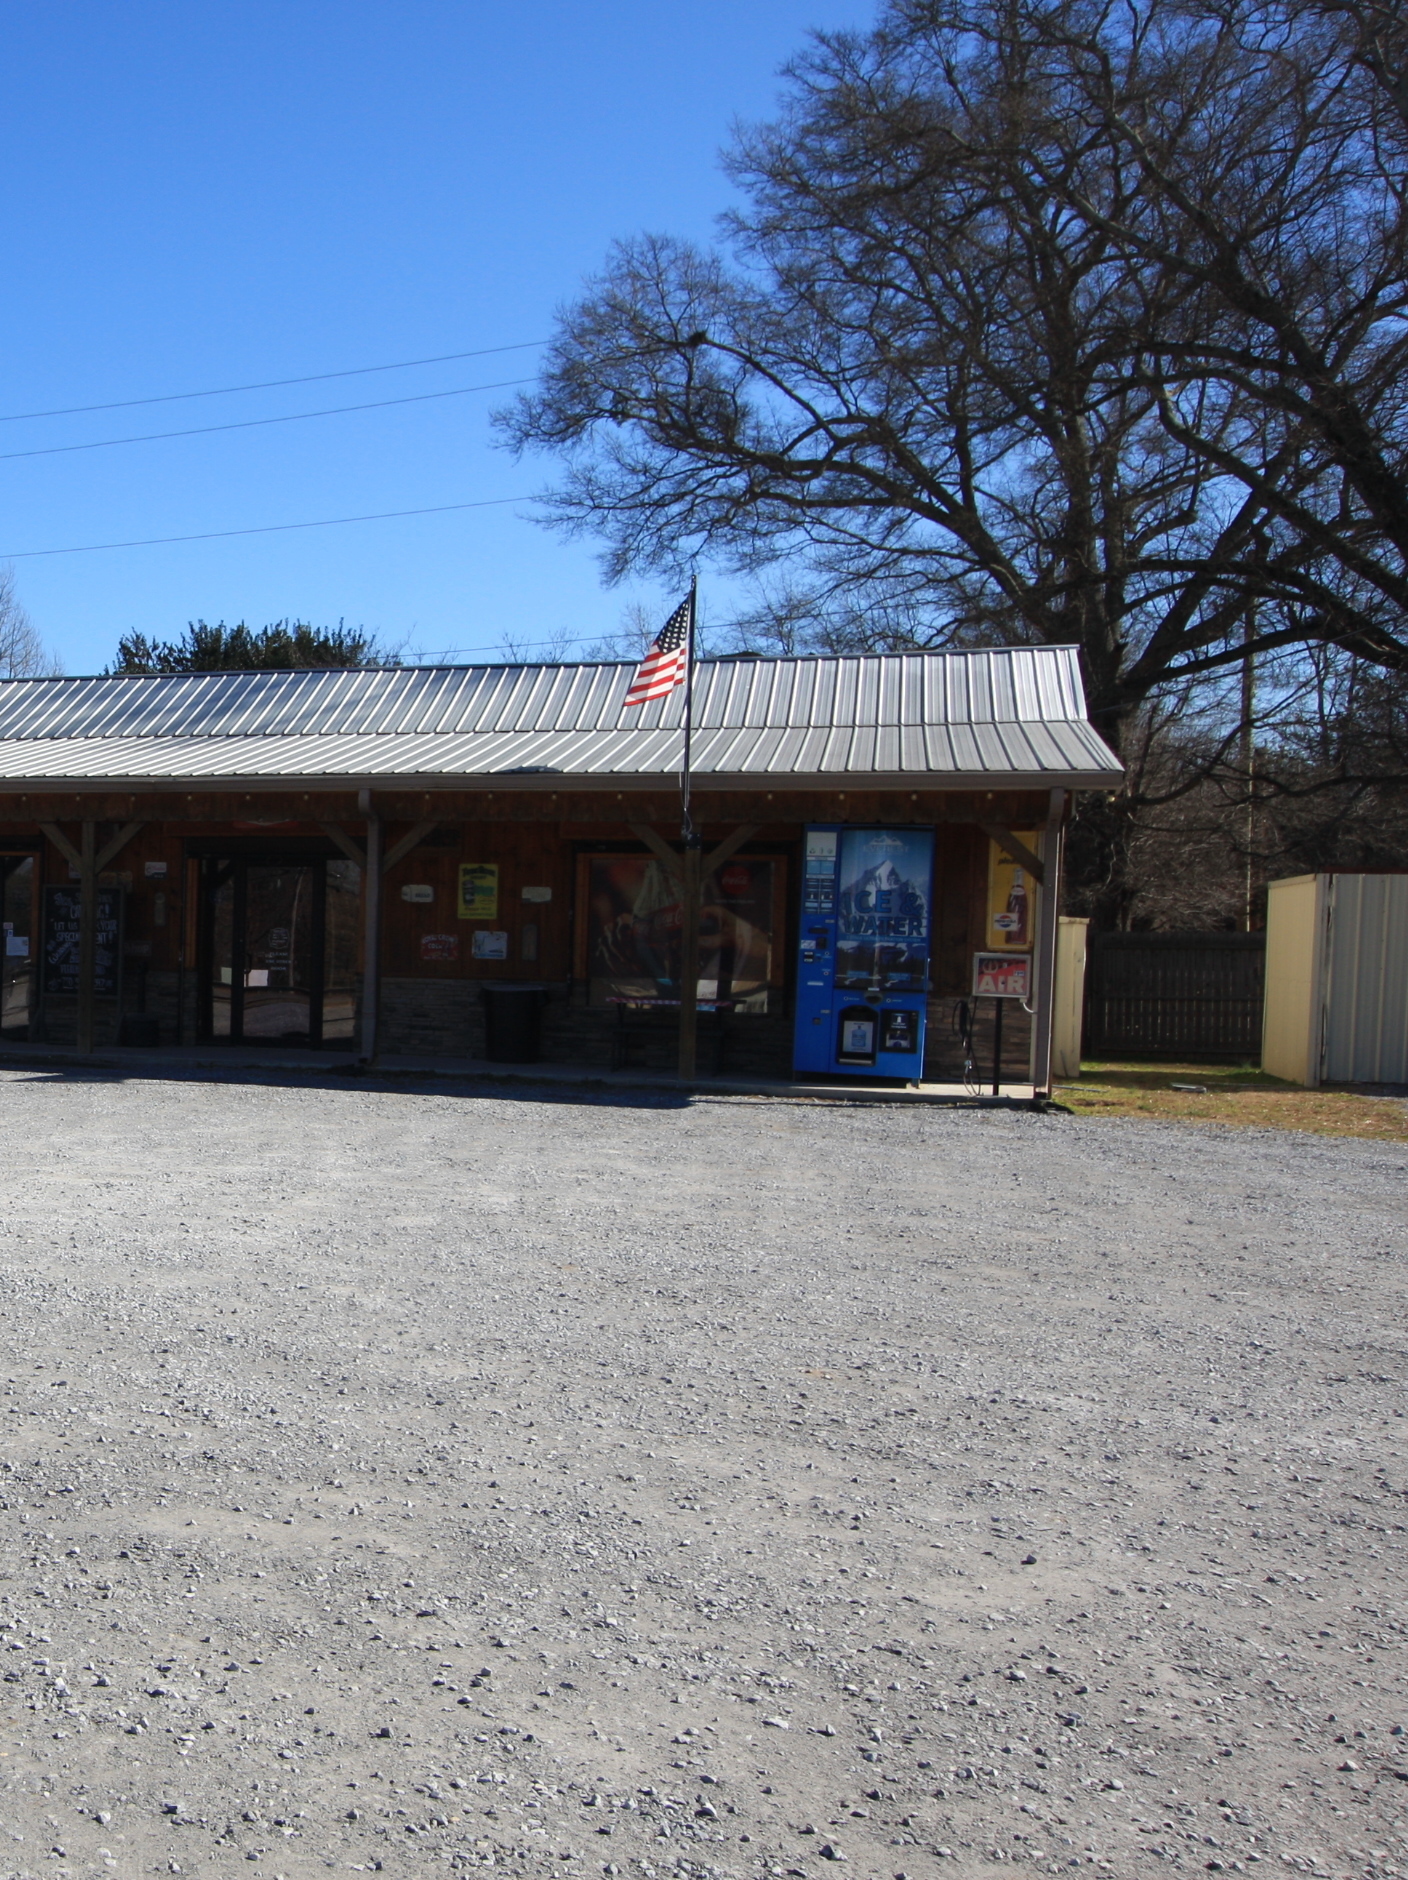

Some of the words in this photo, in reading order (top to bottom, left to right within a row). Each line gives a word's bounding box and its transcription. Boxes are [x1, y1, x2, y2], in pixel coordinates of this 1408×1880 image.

[843, 889, 892, 914] ICE
[900, 892, 924, 917] &
[842, 914, 923, 937] WATER
[978, 974, 1025, 993] AIR
